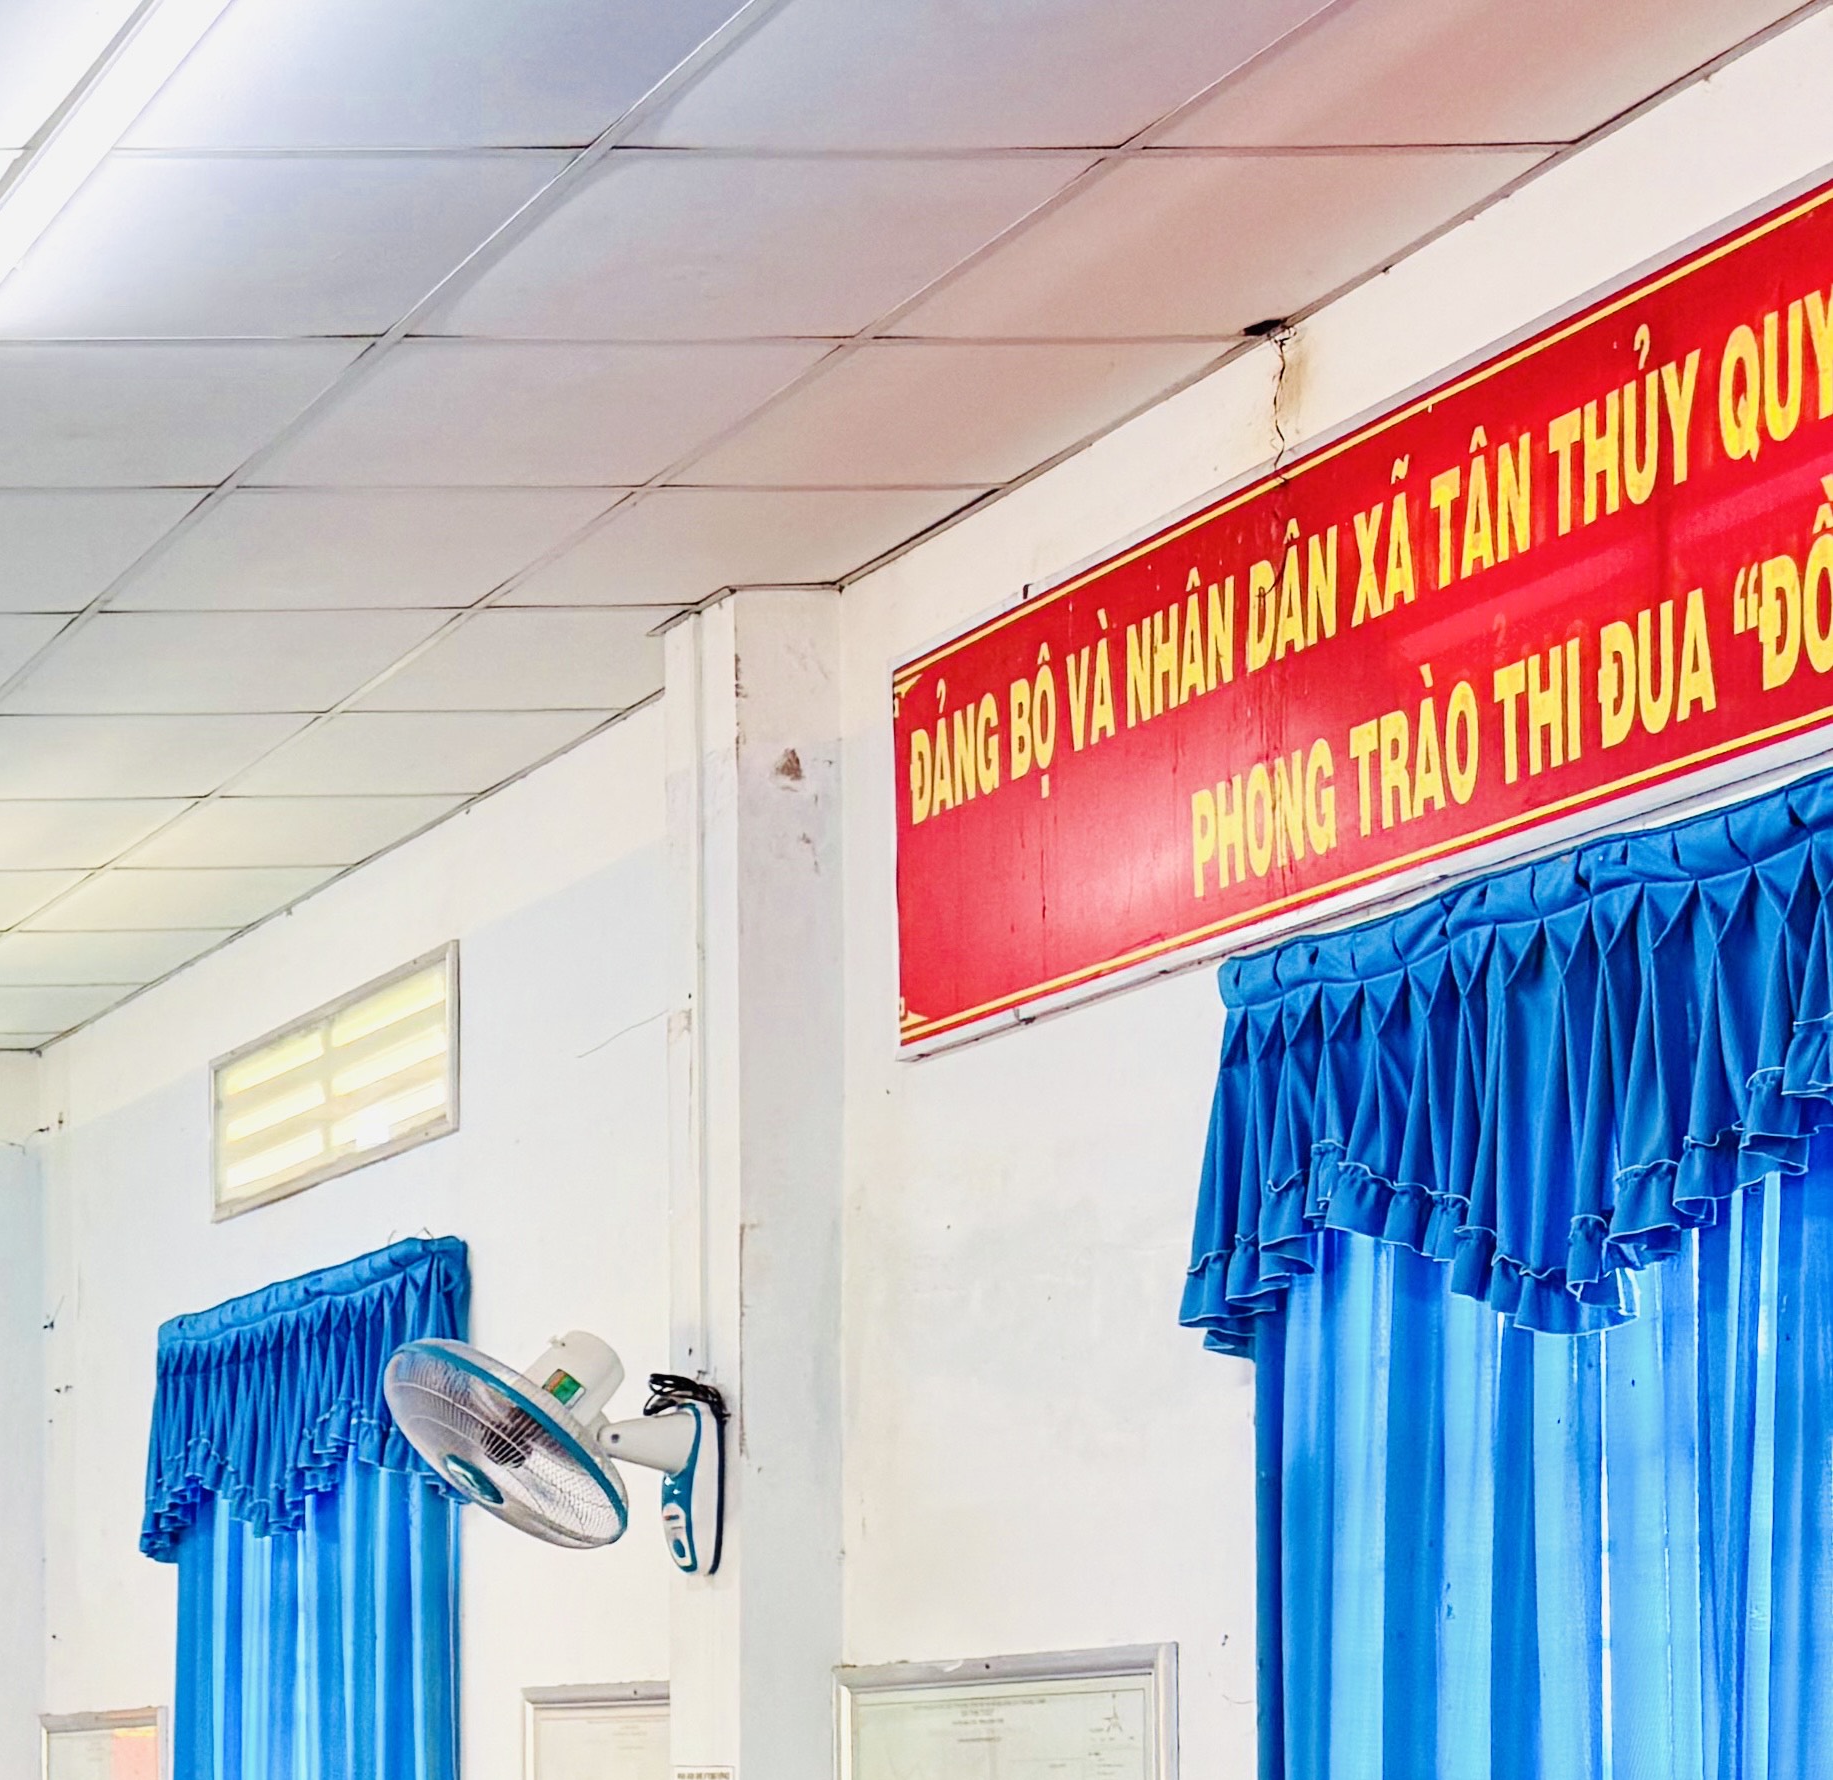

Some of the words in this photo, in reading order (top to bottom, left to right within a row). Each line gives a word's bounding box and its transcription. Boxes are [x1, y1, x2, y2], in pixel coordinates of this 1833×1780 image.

[909, 677, 999, 825] ĐẢNG
[1010, 641, 1056, 799] BỘ
[1066, 607, 1115, 752] VÀ
[1126, 566, 1234, 729] NHÂN
[1246, 518, 1338, 674] DÂN
[1350, 453, 1415, 628] XÃ
[1430, 425, 1531, 590] TÂN
[1548, 323, 1701, 536] THỦY
[1191, 737, 1337, 898] PHONG
[1349, 662, 1479, 838] TRÀO
[1493, 637, 1582, 785] THI
[1597, 586, 1717, 749] ĐUA
